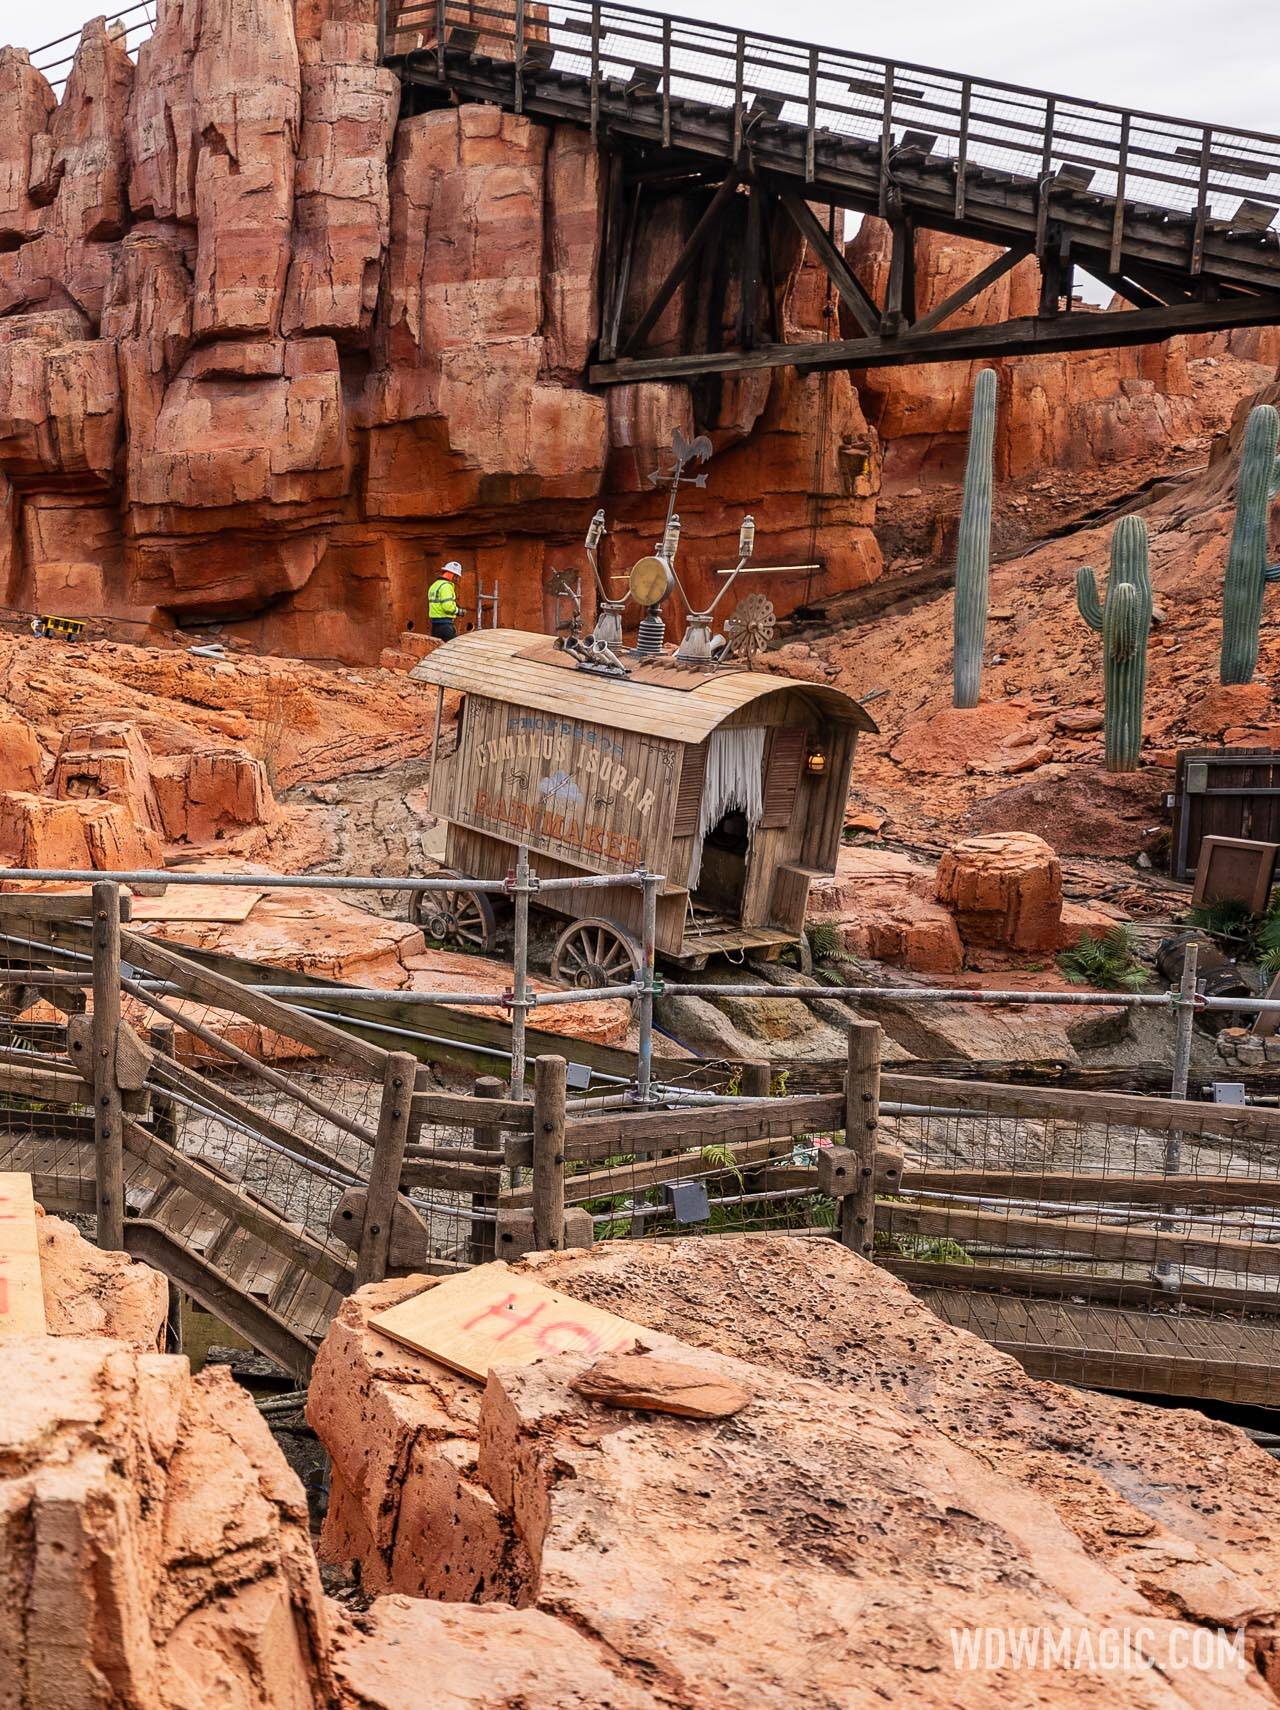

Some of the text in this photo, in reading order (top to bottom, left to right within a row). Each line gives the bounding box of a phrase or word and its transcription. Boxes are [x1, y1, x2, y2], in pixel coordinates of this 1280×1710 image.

[476, 733, 655, 816] CUMULUS ISOBAR
[463, 1293, 630, 1353] HO
